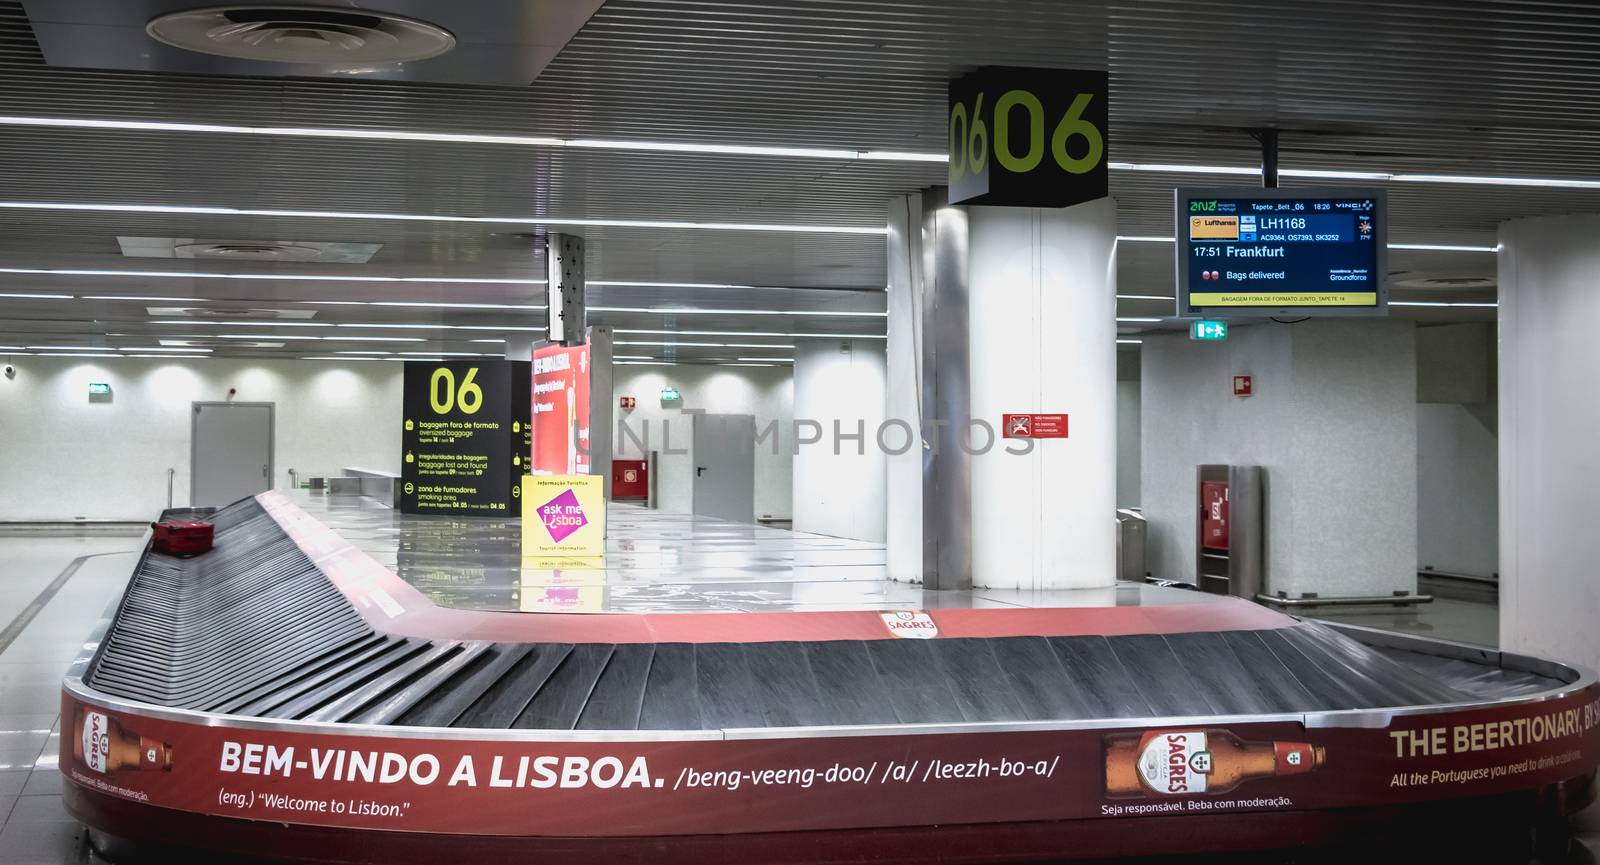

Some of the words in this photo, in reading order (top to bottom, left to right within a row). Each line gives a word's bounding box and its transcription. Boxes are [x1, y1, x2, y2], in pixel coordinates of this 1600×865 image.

[950, 92, 988, 182] 06
[994, 90, 1103, 174] 06
[1252, 203, 1273, 211] Tapete
[1260, 218, 1306, 229] LH1168
[1194, 247, 1220, 257] 17:51
[1226, 246, 1285, 257] Frankfurt
[1226, 271, 1247, 281] Bags
[1248, 271, 1285, 279] delivered
[430, 367, 483, 415] 06
[419, 421, 449, 430] bagagem
[450, 421, 463, 429] fora
[447, 430, 473, 438] baggage
[463, 454, 488, 462] bagagem
[418, 461, 444, 469] baggage
[443, 486, 477, 494] fumadores
[418, 494, 442, 502] smoking
[543, 504, 562, 514] ask
[565, 506, 582, 514] me
[888, 621, 935, 630] SAGRES
[1390, 727, 1447, 758] THE
[1453, 707, 1583, 753] BEERTIONARY,
[1584, 701, 1594, 730] BY
[90, 714, 100, 770] SAGRES
[220, 741, 441, 786] BEM-VINDO
[447, 754, 477, 787] A
[489, 755, 665, 789] LISBOA.
[673, 761, 877, 791] /beng-veeng-doo/
[881, 760, 918, 784] /a/
[923, 755, 1060, 783] /leezh-bo-a/
[1167, 735, 1188, 793] SAGRES
[1390, 773, 1407, 787] All
[1410, 771, 1429, 785] the
[1431, 765, 1489, 784] Portuguese
[1490, 764, 1507, 780] you
[1508, 760, 1528, 774] need
[1529, 760, 1536, 770] to
[1538, 755, 1555, 769] drink
[119, 787, 150, 801] moderação.
[219, 787, 255, 809] (eng.)
[331, 799, 345, 813] to
[1102, 804, 1123, 816] Seja
[1125, 801, 1185, 814] responsável.
[1188, 800, 1212, 810] Beba
[1214, 801, 1235, 809] com
[1237, 796, 1293, 808] moderação.
